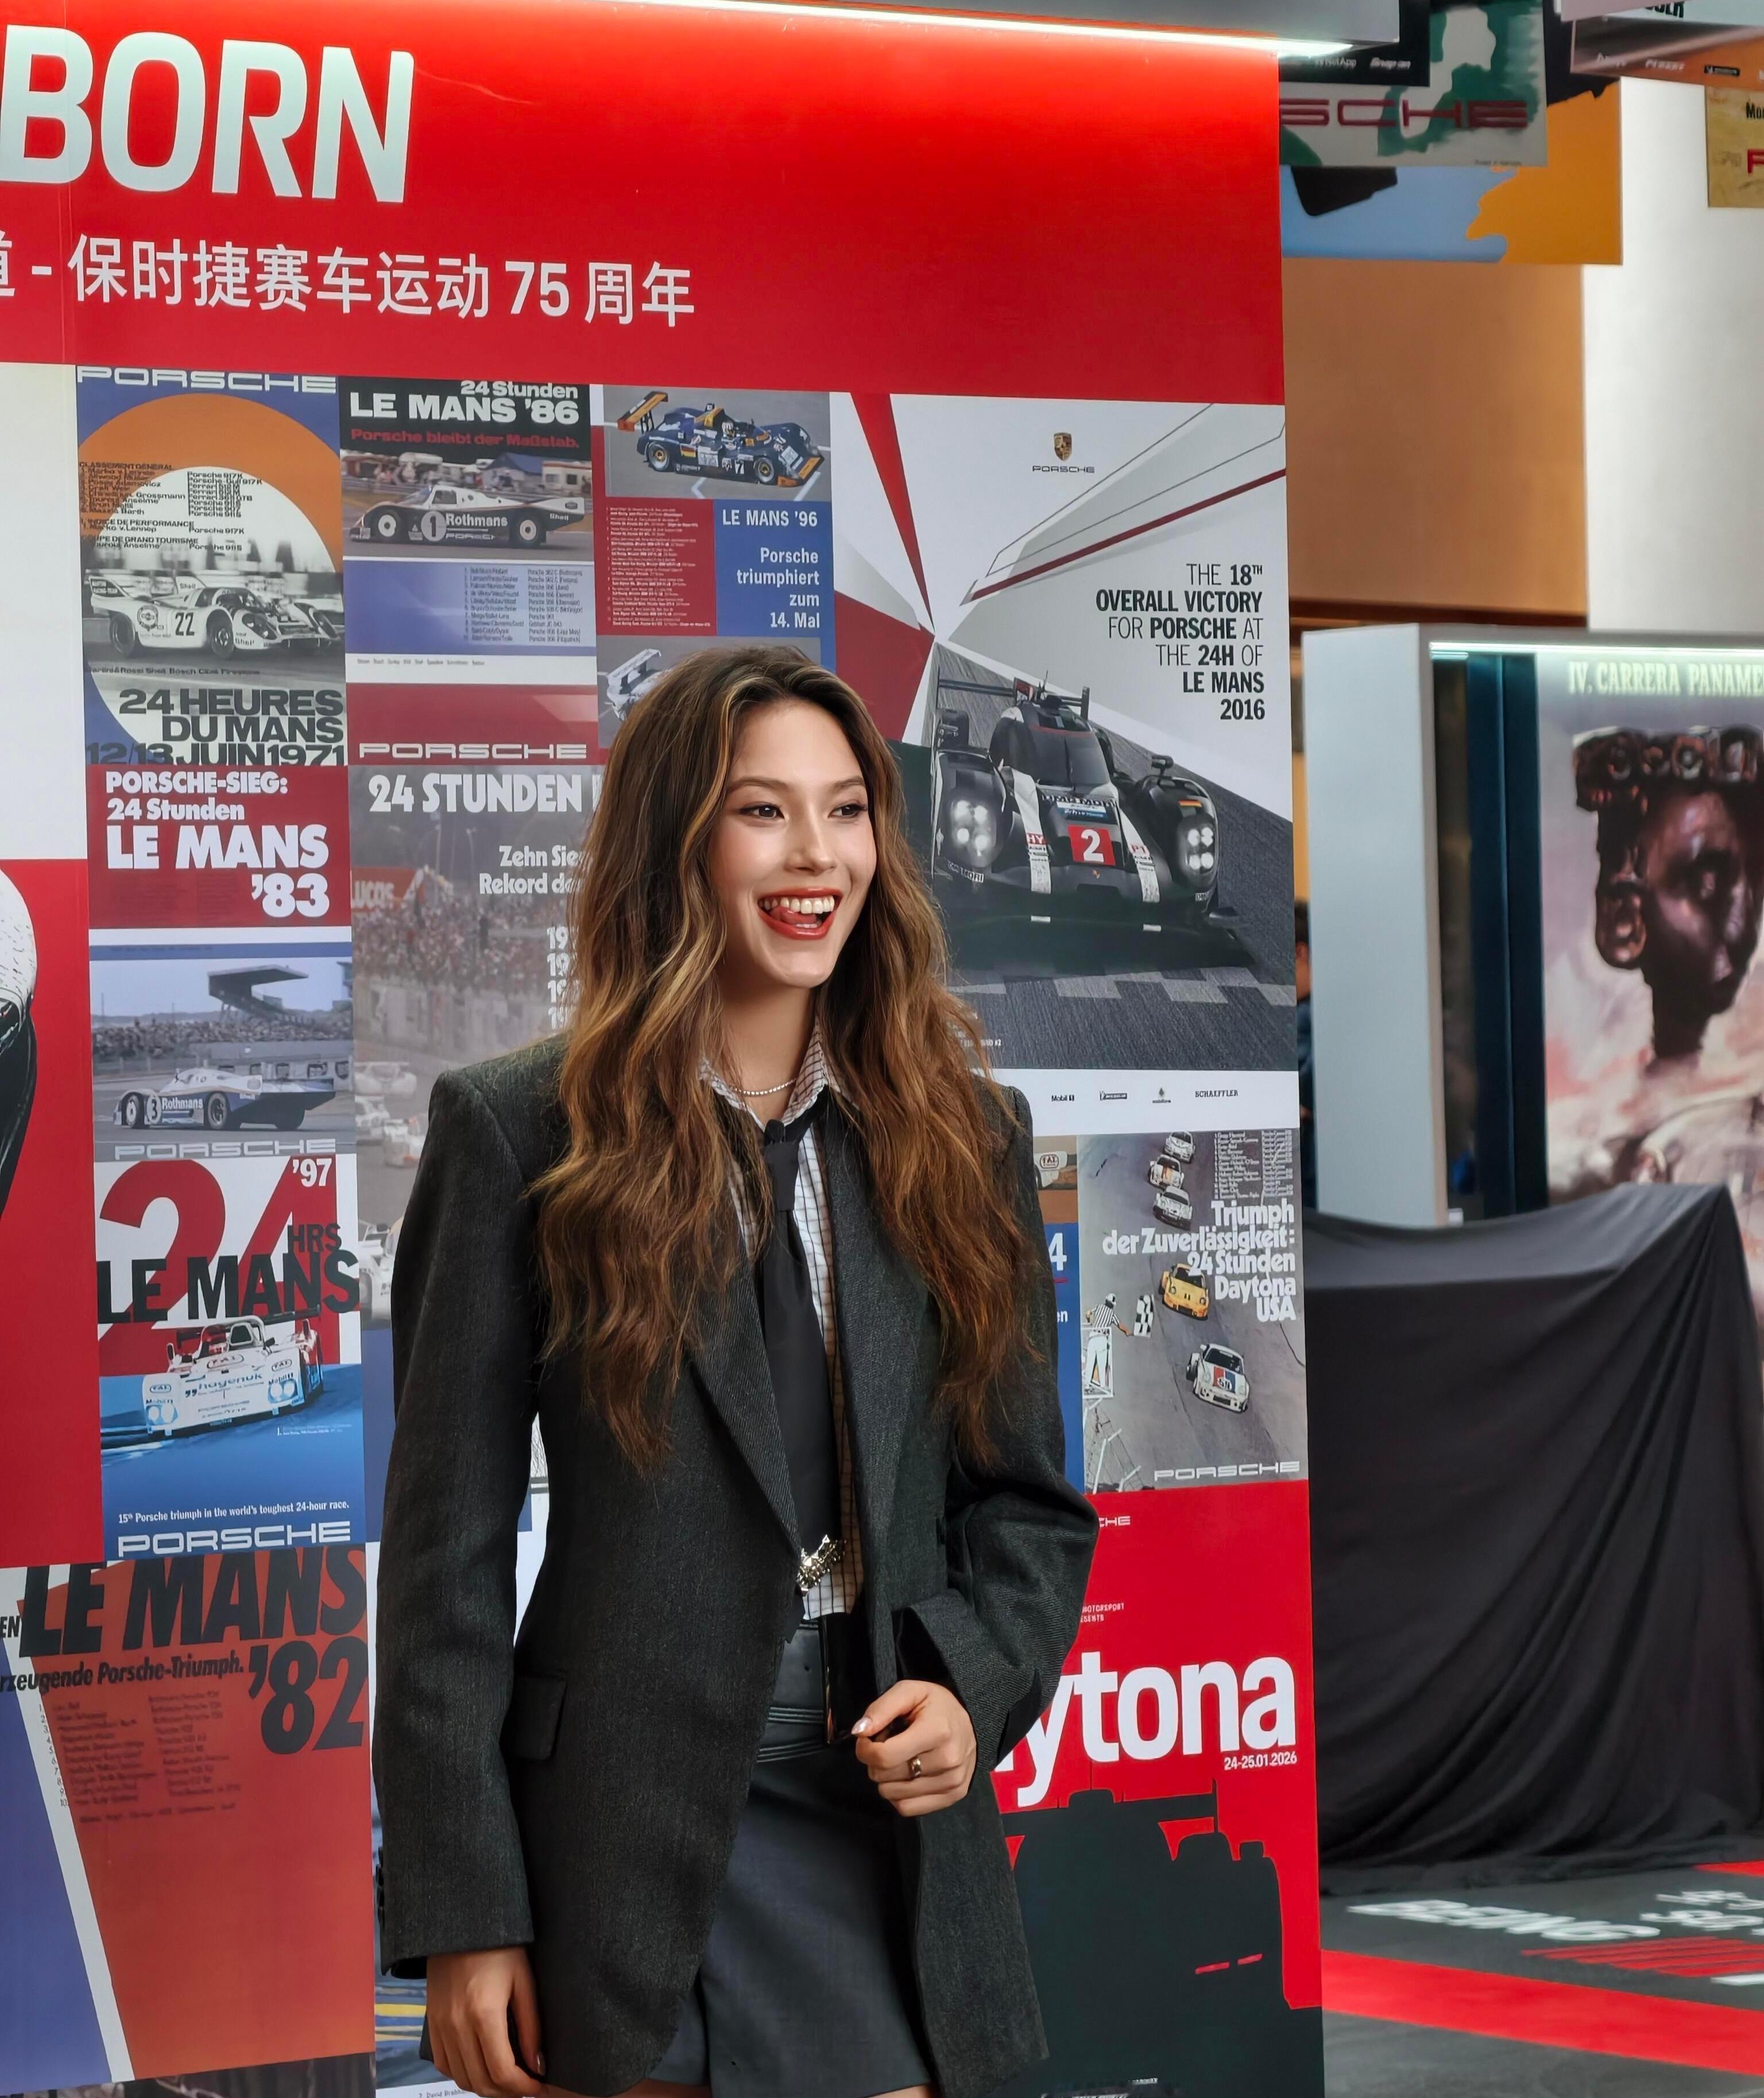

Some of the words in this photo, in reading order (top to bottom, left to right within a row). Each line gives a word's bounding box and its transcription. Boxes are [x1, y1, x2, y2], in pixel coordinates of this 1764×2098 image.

[0, 24, 415, 203] BORN
[67, 233, 490, 319] 保时捷赛车运动
[505, 261, 570, 317] 75
[585, 261, 694, 327] 周年
[77, 366, 336, 393] PORSCHE
[461, 380, 489, 396] 24
[493, 381, 578, 399] Stunden
[350, 392, 397, 419] LE
[408, 394, 517, 423] MANS
[525, 398, 579, 425] '86
[350, 428, 423, 444] Porsche
[426, 429, 471, 446] bleibt
[474, 432, 506, 446] der
[1032, 465, 1095, 474] PORSCHE
[446, 513, 508, 528] Rothmans
[722, 509, 740, 526] LE
[746, 509, 790, 527] MANS
[795, 510, 818, 527] '96
[760, 547, 818, 564] Porsche
[737, 569, 819, 586] triumphiert
[1186, 563, 1222, 586] THE
[1230, 563, 1263, 586] 18TH
[790, 594, 819, 606] zum
[1096, 589, 1179, 612] OVERALL
[1185, 590, 1263, 613] VICTORY
[175, 612, 195, 636] 22
[770, 613, 791, 628] 14.
[794, 612, 821, 629] Mal
[1108, 617, 1143, 639] FOR
[1150, 617, 1237, 640] PORSCHE
[1243, 618, 1264, 640] AT
[1155, 644, 1192, 666] THE
[1198, 644, 1235, 667] 24H
[1241, 645, 1264, 667] OF
[1183, 671, 1205, 693] LE
[1212, 672, 1264, 694] MANS
[1597, 661, 1681, 696] CARRERA
[119, 689, 174, 715] 24
[179, 690, 345, 717] HEURES
[1220, 698, 1265, 721] 2016
[162, 715, 218, 742] DU
[225, 716, 344, 744] MANS
[174, 742, 265, 766] JUIN
[266, 743, 345, 767] 1971
[359, 743, 587, 760] PORSCHE
[106, 771, 288, 794] PORSCHE-SIEG:
[369, 774, 415, 812] 24
[422, 773, 582, 812] STUNDEN
[107, 798, 142, 820] 24
[147, 797, 245, 820] Stunden
[107, 825, 160, 870] LE
[175, 824, 330, 869] MANS
[1027, 834, 1045, 844] HY
[1081, 829, 1105, 862] 2
[498, 845, 548, 867] Zehn
[251, 873, 330, 918] '83
[479, 872, 548, 895] Rekord
[547, 926, 574, 949] 19
[547, 953, 574, 977] 19
[161, 1097, 204, 1111] Rothmans
[1051, 1094, 1068, 1102] Mobil
[115, 1138, 336, 1160] PORSCHE
[292, 1159, 332, 1187] '97
[1210, 1198, 1295, 1229] Triumph
[287, 1223, 342, 1253] HRS
[1102, 1230, 1139, 1255] der
[1142, 1224, 1295, 1255] Zuverlässigkeit:
[1187, 1251, 1212, 1276] 24
[1216, 1249, 1295, 1274] Stunden
[96, 1258, 168, 1324] LE
[187, 1248, 360, 1319] MANS
[1214, 1274, 1296, 1303] Daytona
[1255, 1295, 1297, 1322] USA
[1154, 1461, 1300, 1481] PORSCHE
[135, 1511, 169, 1523] Porsche
[170, 1508, 202, 1520] triumph
[204, 1507, 212, 1518] in
[214, 1507, 227, 1518] the
[259, 1502, 294, 1515] toughest
[118, 1520, 351, 1557] PORSCHE
[19, 1562, 107, 1658] LE
[122, 1547, 367, 1651] MANS
[97, 1648, 244, 1686] Porsche-Triumph.
[249, 1636, 369, 1755] '82
[995, 1651, 1297, 1807] ytona
[1224, 1751, 1297, 1771] 24-25.01.2026
